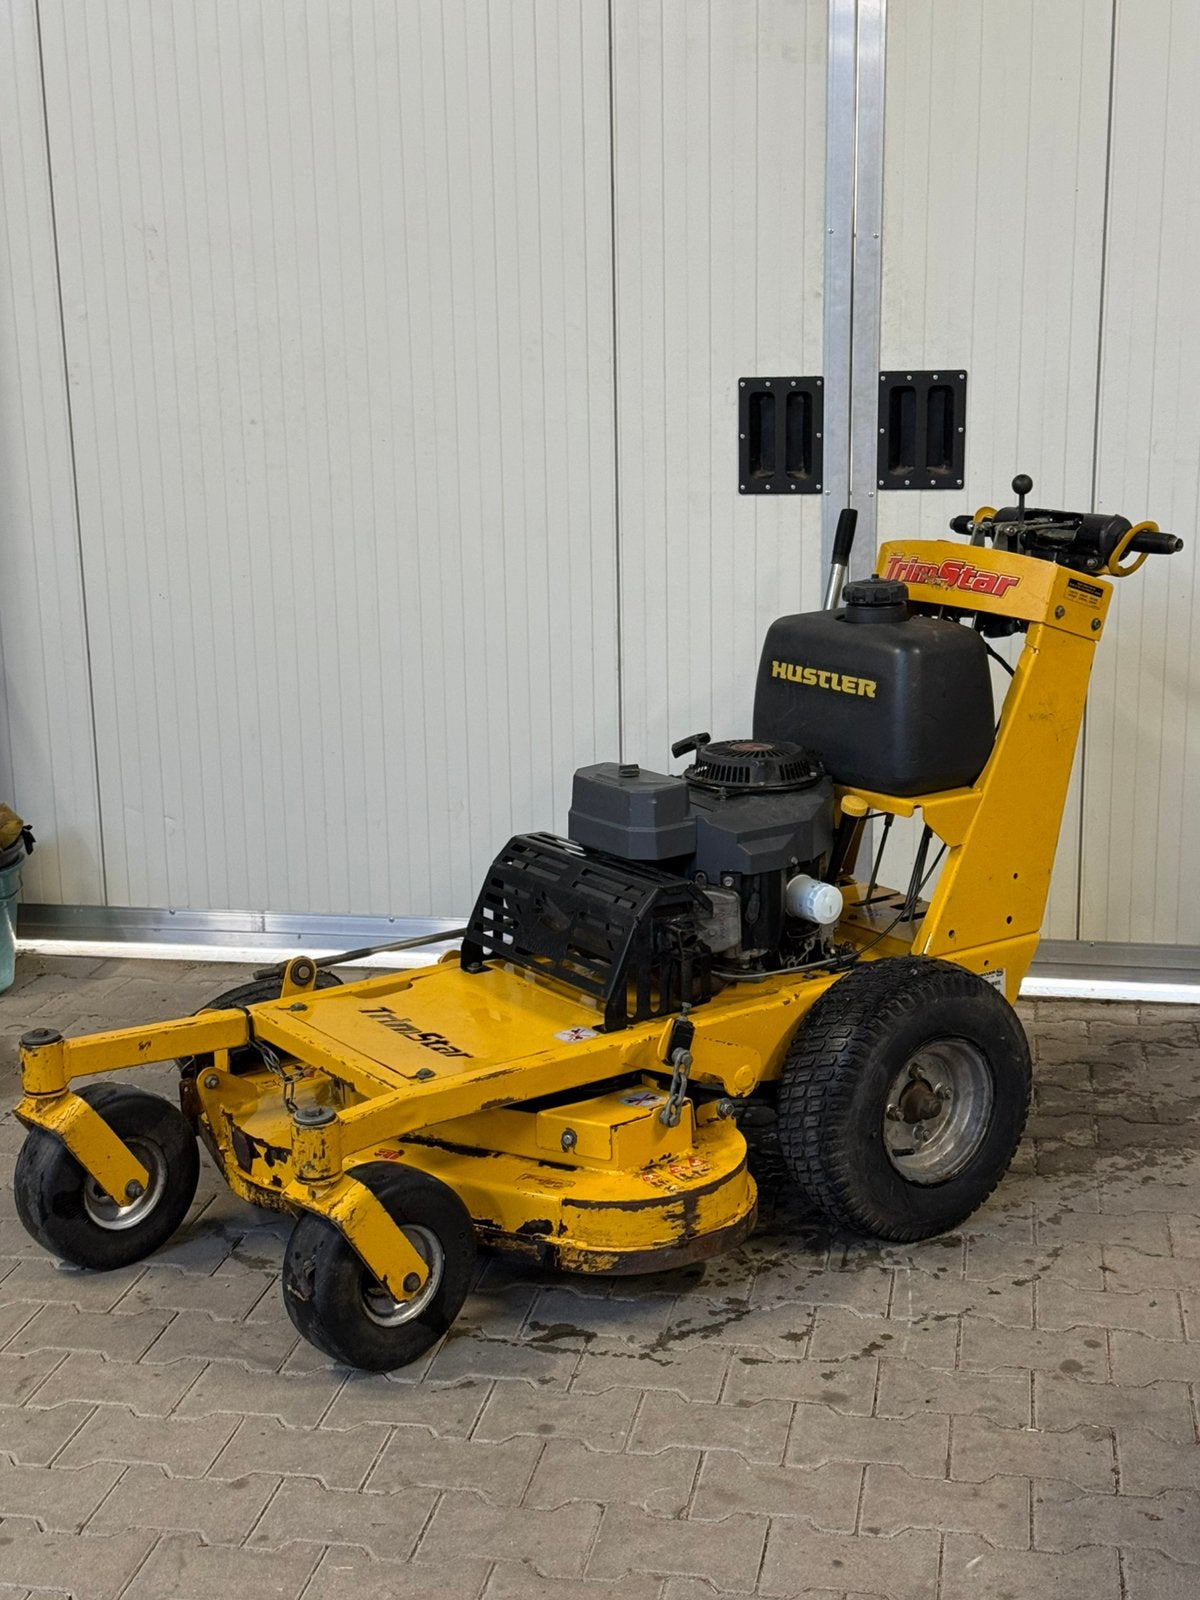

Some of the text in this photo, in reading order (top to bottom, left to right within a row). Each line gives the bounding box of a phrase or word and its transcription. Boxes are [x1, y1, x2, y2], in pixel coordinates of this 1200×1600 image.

[887, 554, 1020, 597] TrimStar
[772, 661, 877, 698] HUSTLER
[358, 1007, 474, 1058] TrimStar
